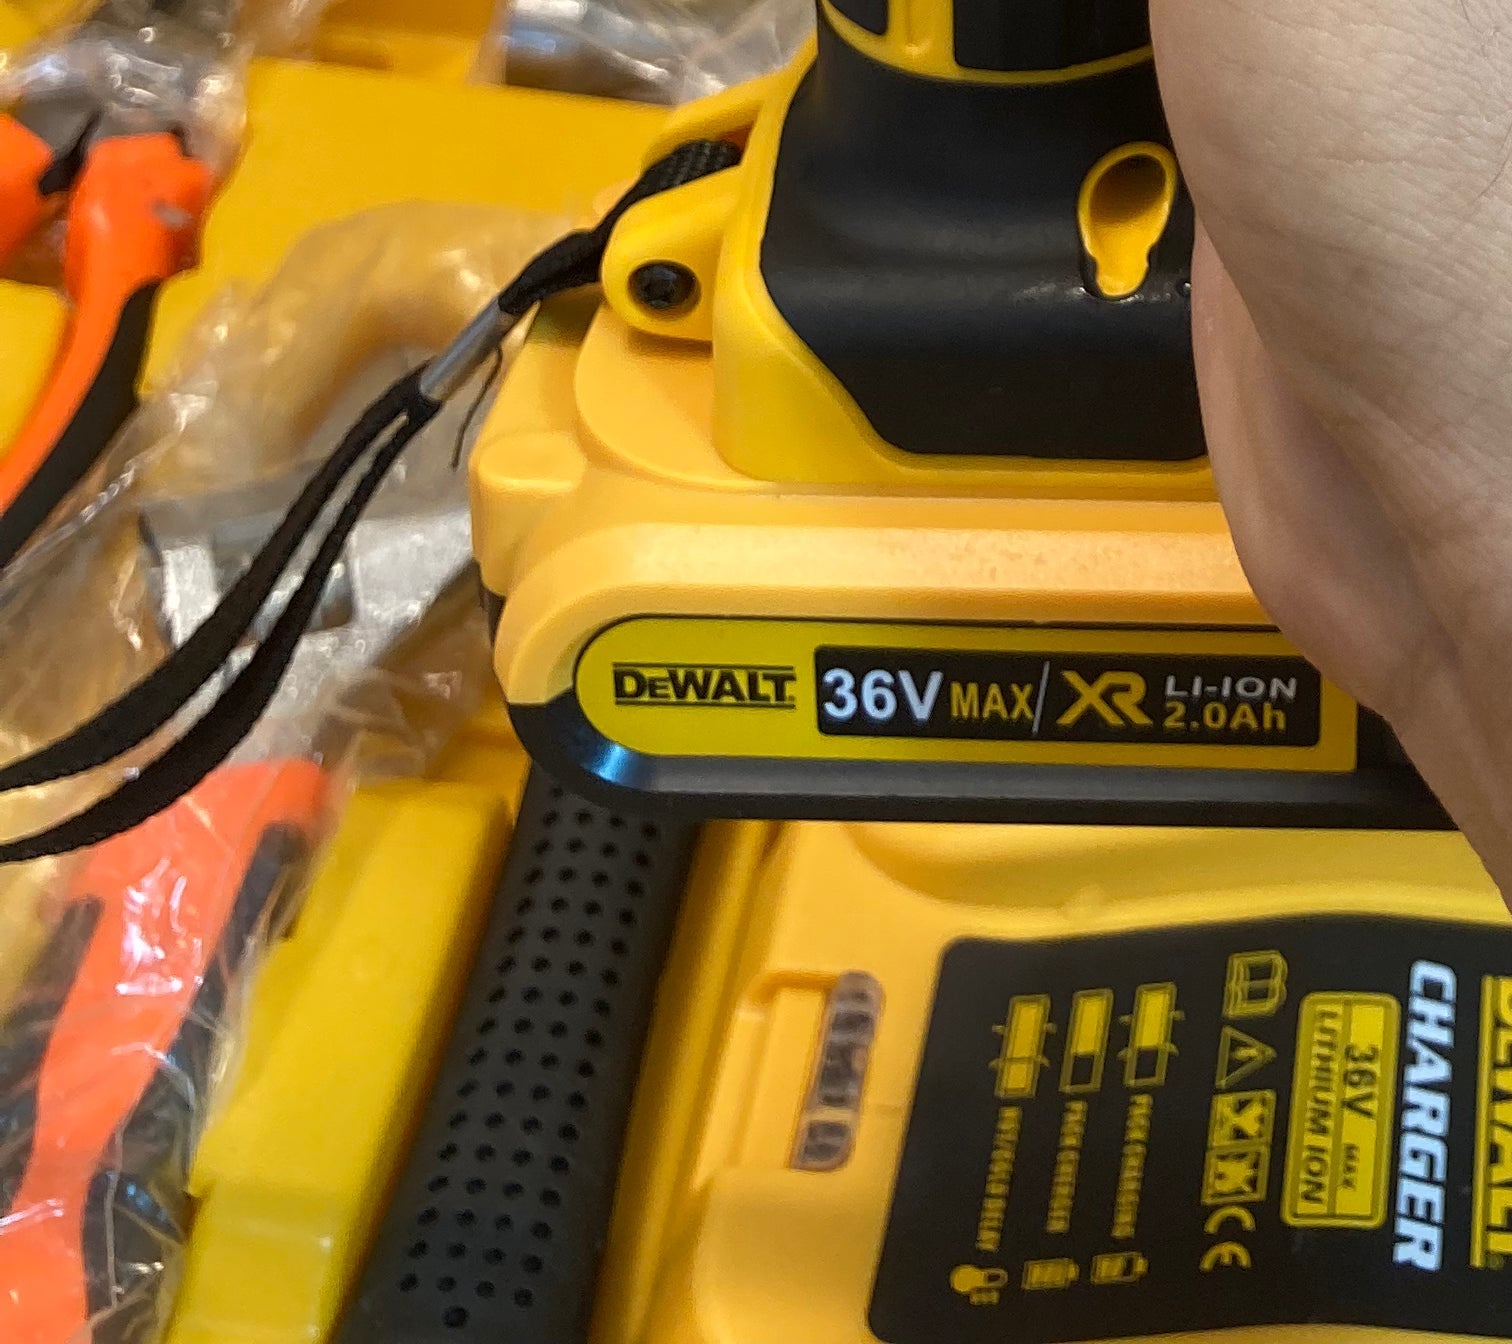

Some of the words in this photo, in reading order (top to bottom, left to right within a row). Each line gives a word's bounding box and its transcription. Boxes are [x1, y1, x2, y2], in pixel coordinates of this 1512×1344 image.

[613, 667, 796, 704] DEWALT
[823, 667, 944, 724] 36V
[1057, 670, 1154, 727] XR
[1165, 675, 1297, 700] LI-ION
[1163, 700, 1287, 733] 2.0Ah
[1305, 1010, 1341, 1134] LITHIUM
[1341, 1044, 1380, 1120] 36V
[1392, 959, 1458, 1273] CHARGER
[1299, 1143, 1330, 1204] ION
